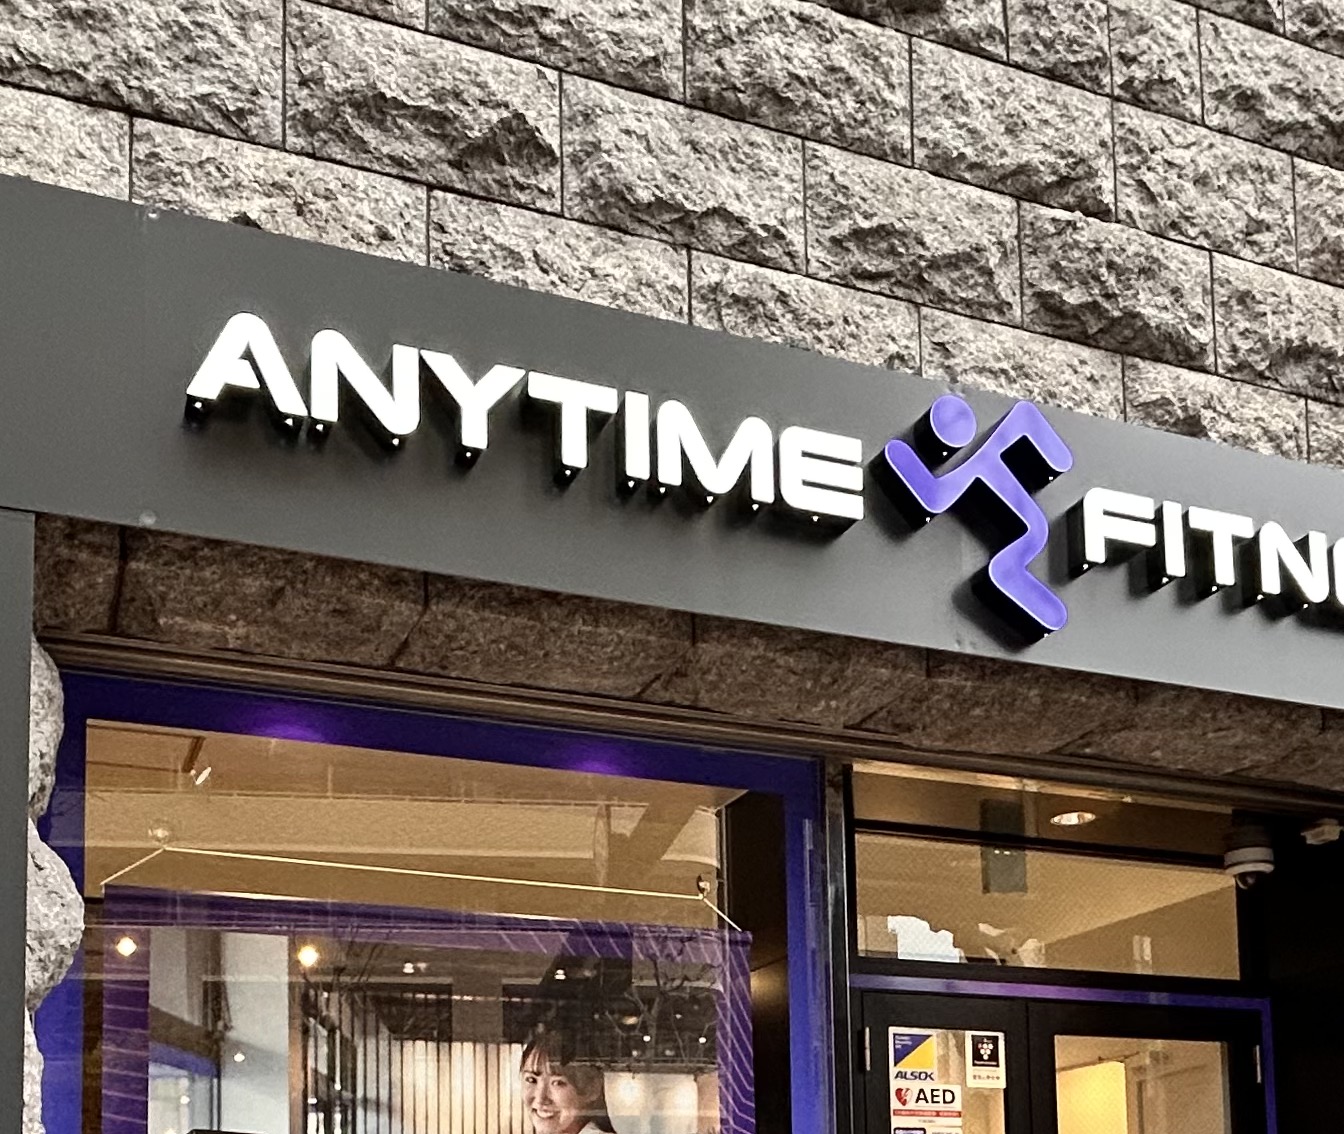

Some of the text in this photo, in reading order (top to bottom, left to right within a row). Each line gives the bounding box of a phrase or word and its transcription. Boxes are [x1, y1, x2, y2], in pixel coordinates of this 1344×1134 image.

[186, 312, 864, 520] ANYTIME
[894, 1070, 935, 1081] ALSOK
[915, 1088, 955, 1104] AED
